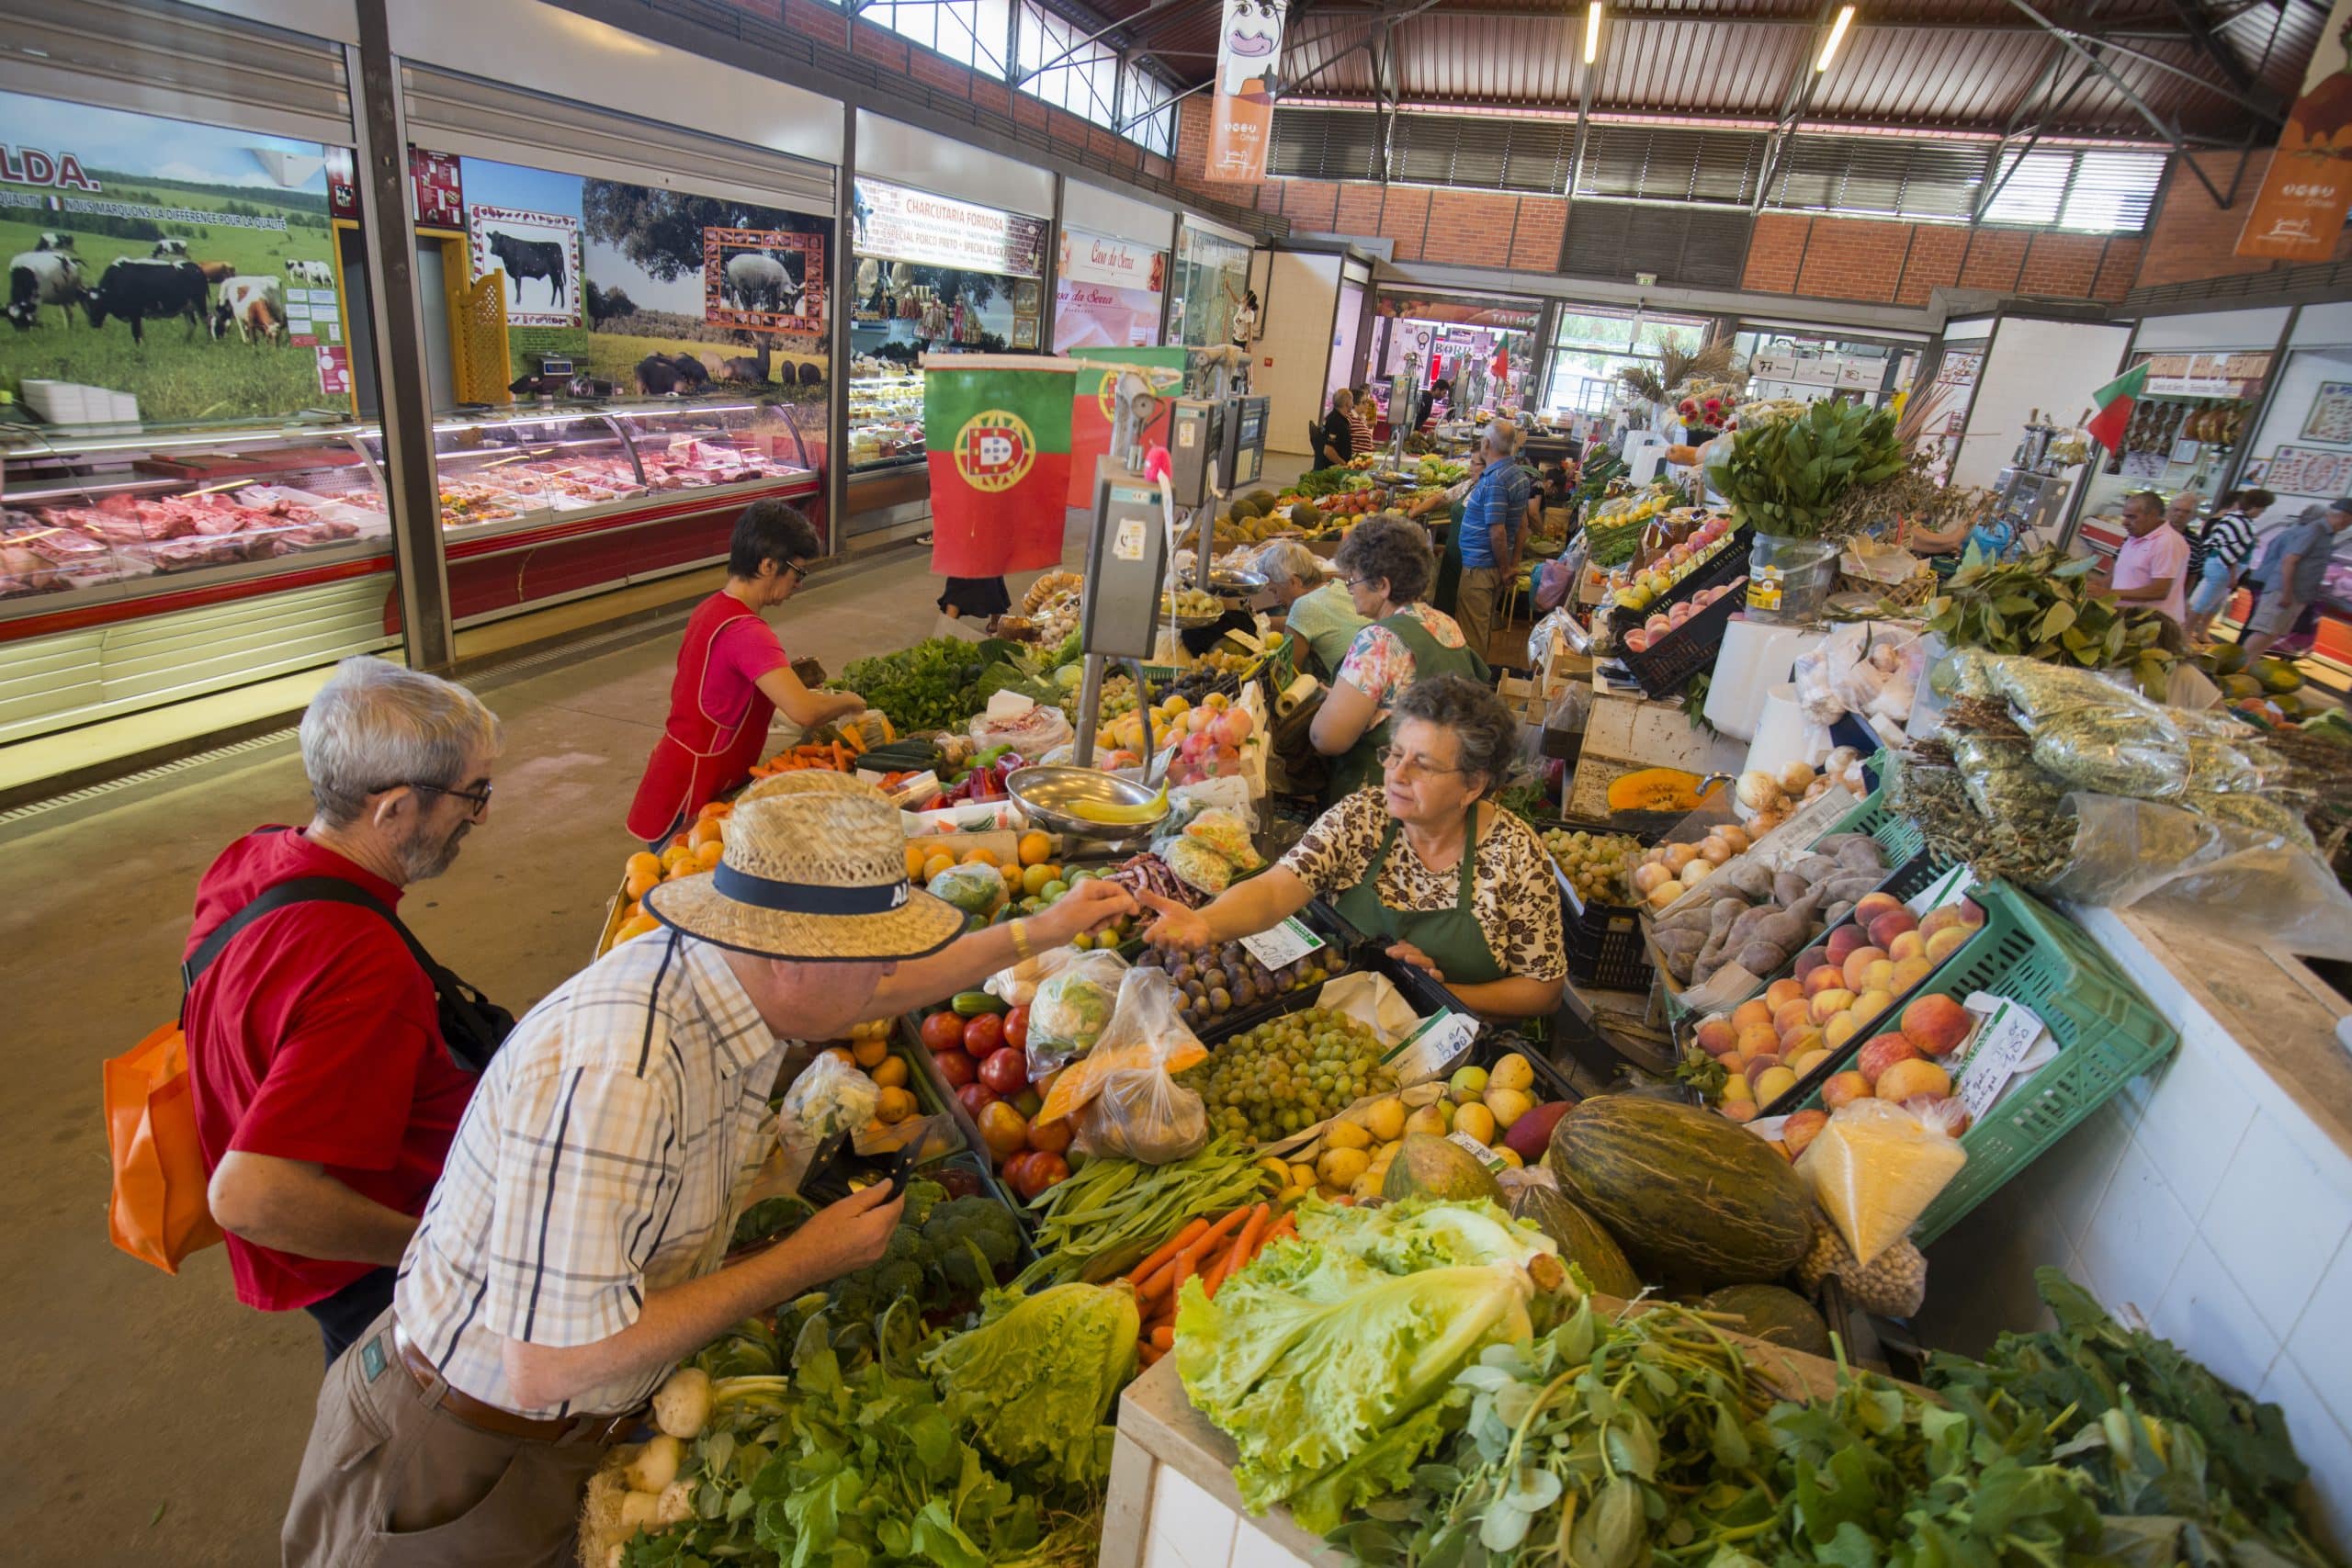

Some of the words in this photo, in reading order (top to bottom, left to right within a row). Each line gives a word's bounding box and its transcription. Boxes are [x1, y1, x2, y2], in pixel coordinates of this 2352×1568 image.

[64, 197, 93, 213] NOUS
[95, 200, 151, 220] MARQUONS
[153, 206, 164, 220] LA
[220, 212, 242, 227] POUR
[967, 211, 1004, 231] FORMOSA
[883, 226, 914, 243] ESPECIAL
[916, 232, 937, 247] PORCO
[938, 236, 958, 251] PRETO
[1091, 239, 1107, 265] Casa
[1108, 246, 1117, 266] da
[1118, 244, 1134, 270] Serra
[1072, 289, 1084, 301] da
[1087, 288, 1113, 304] Serra
[1492, 313, 1537, 327] TALHO
